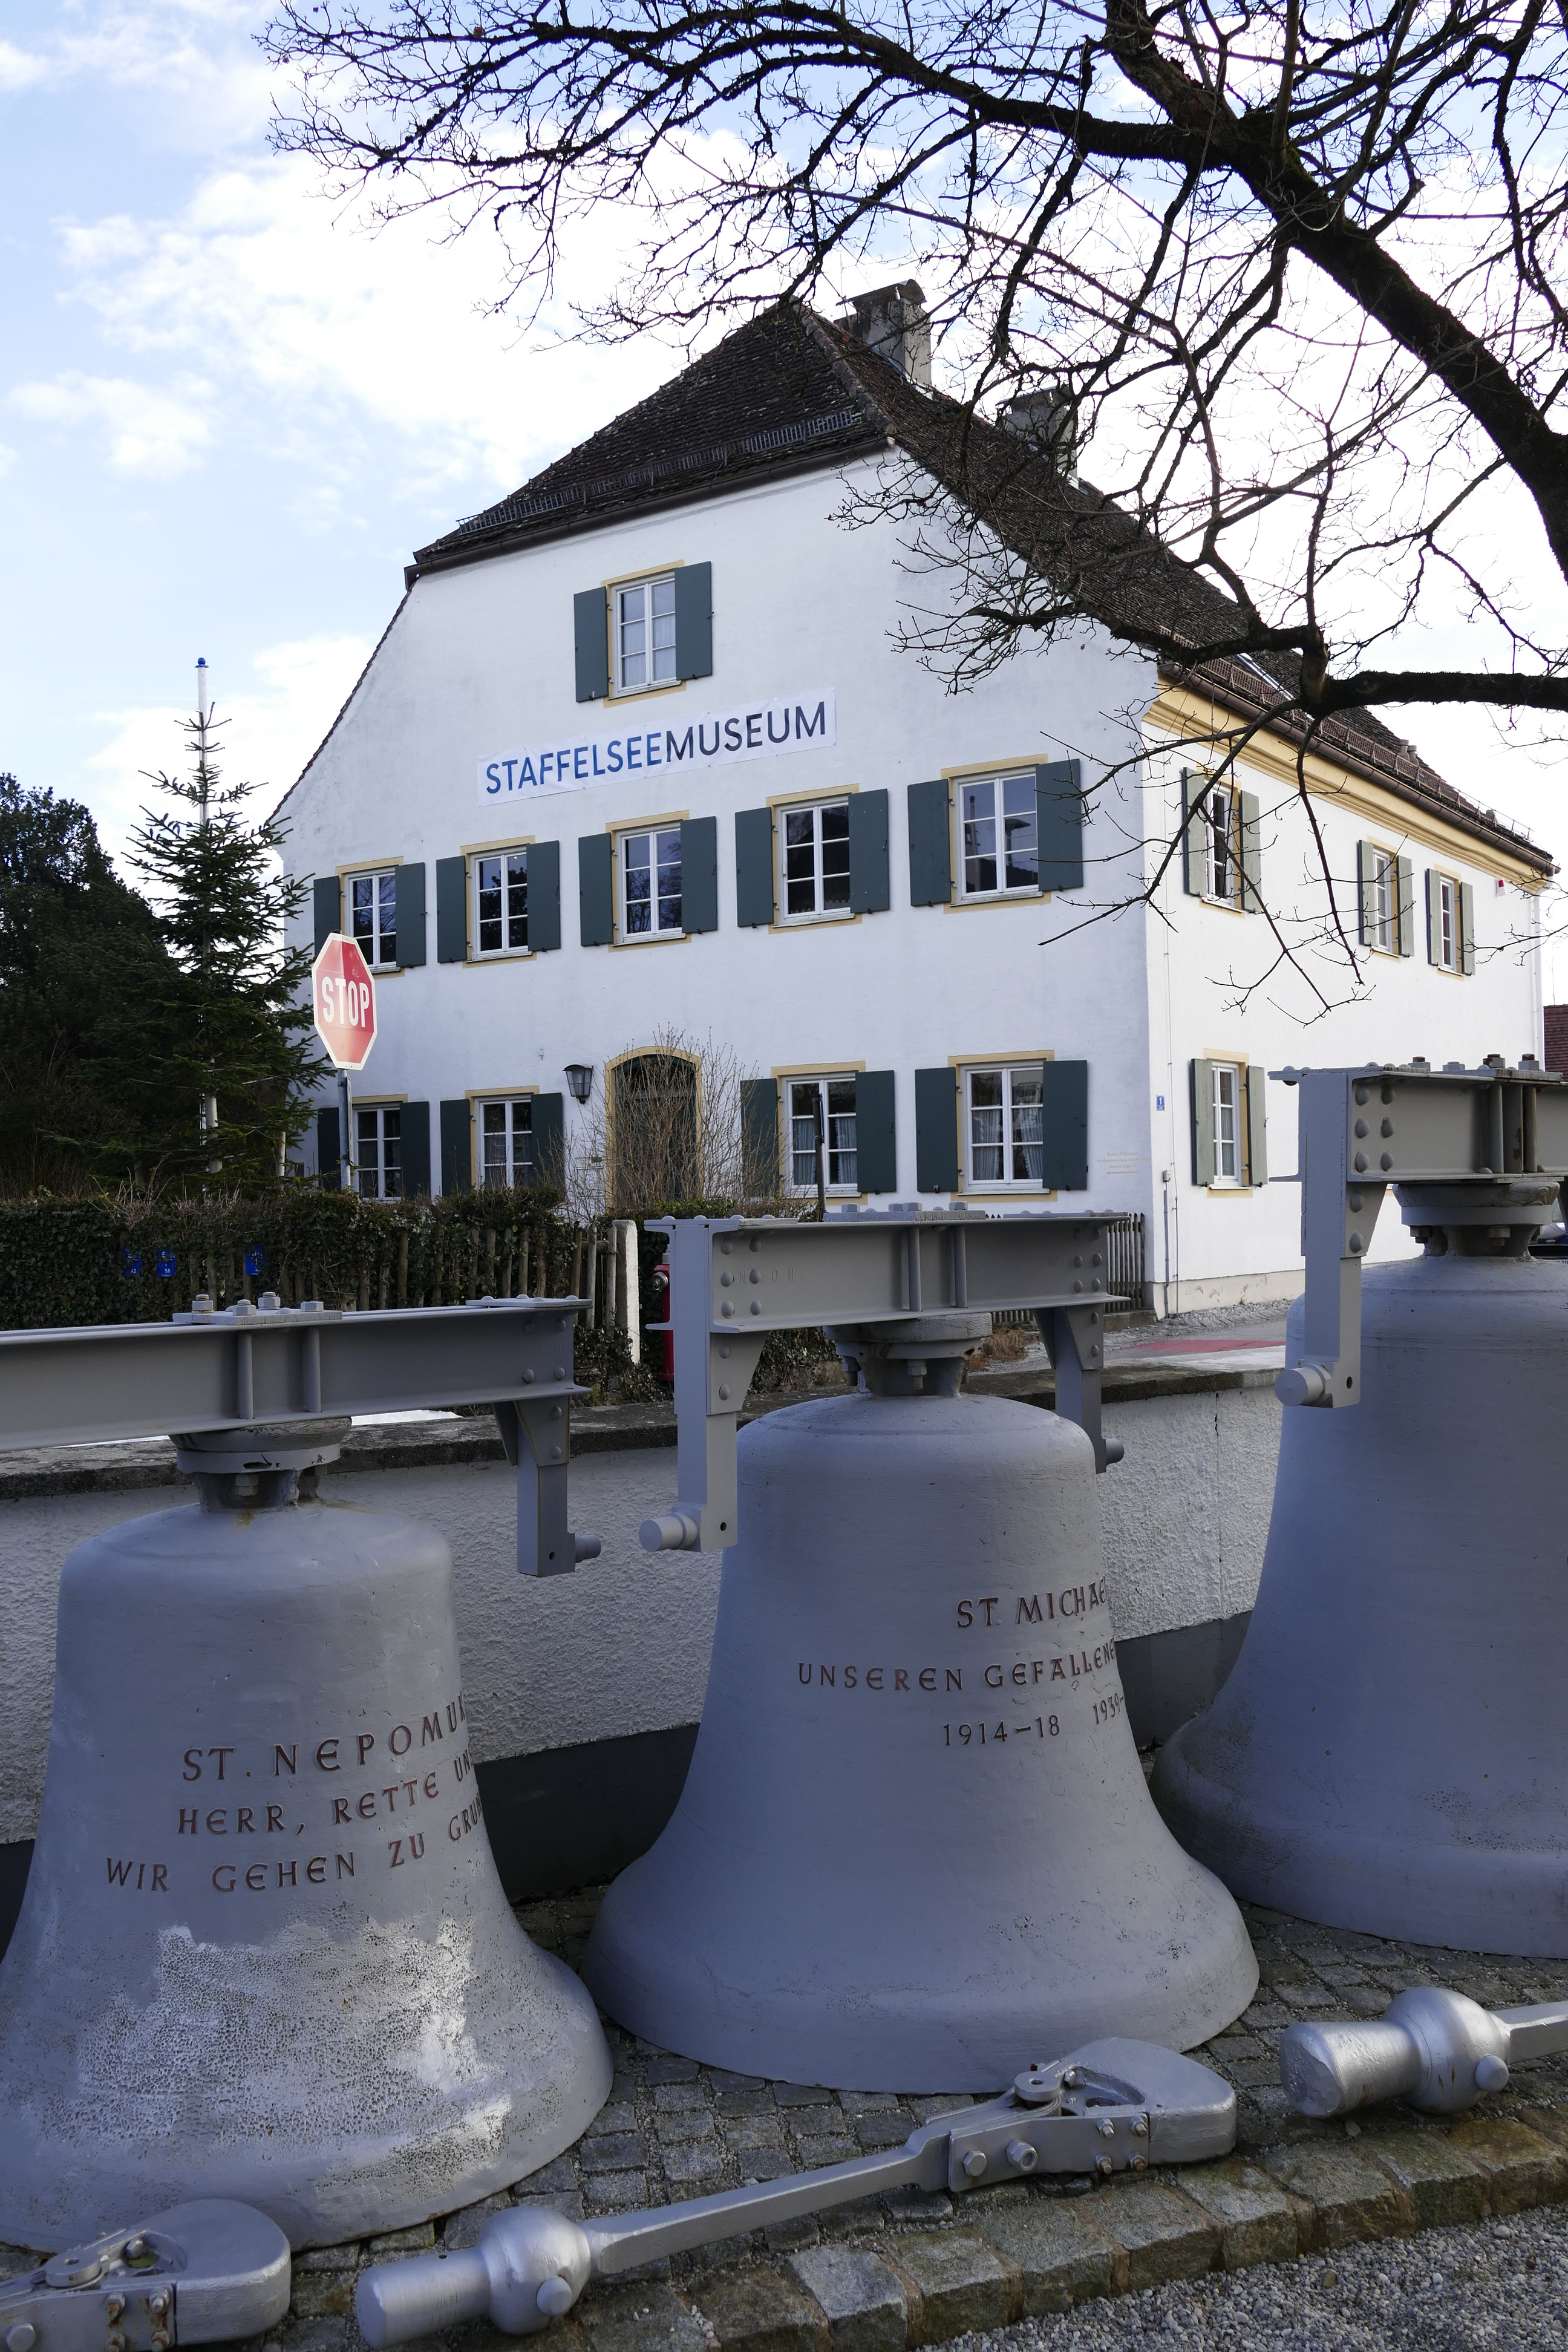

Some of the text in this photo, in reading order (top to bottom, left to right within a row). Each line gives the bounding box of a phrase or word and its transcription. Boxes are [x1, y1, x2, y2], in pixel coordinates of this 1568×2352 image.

[486, 701, 825, 794] STAFFELSEEMUSEUM
[321, 976, 370, 1027] STOP
[799, 1662, 962, 1691] UNSEREN
[183, 1692, 465, 1780] ST. NEPOMUK
[178, 1742, 474, 1836] HERR, RETTE UN
[106, 1857, 169, 1892] WIR
[212, 1852, 354, 1892] GEHEN
[388, 1833, 424, 1868] ZU
